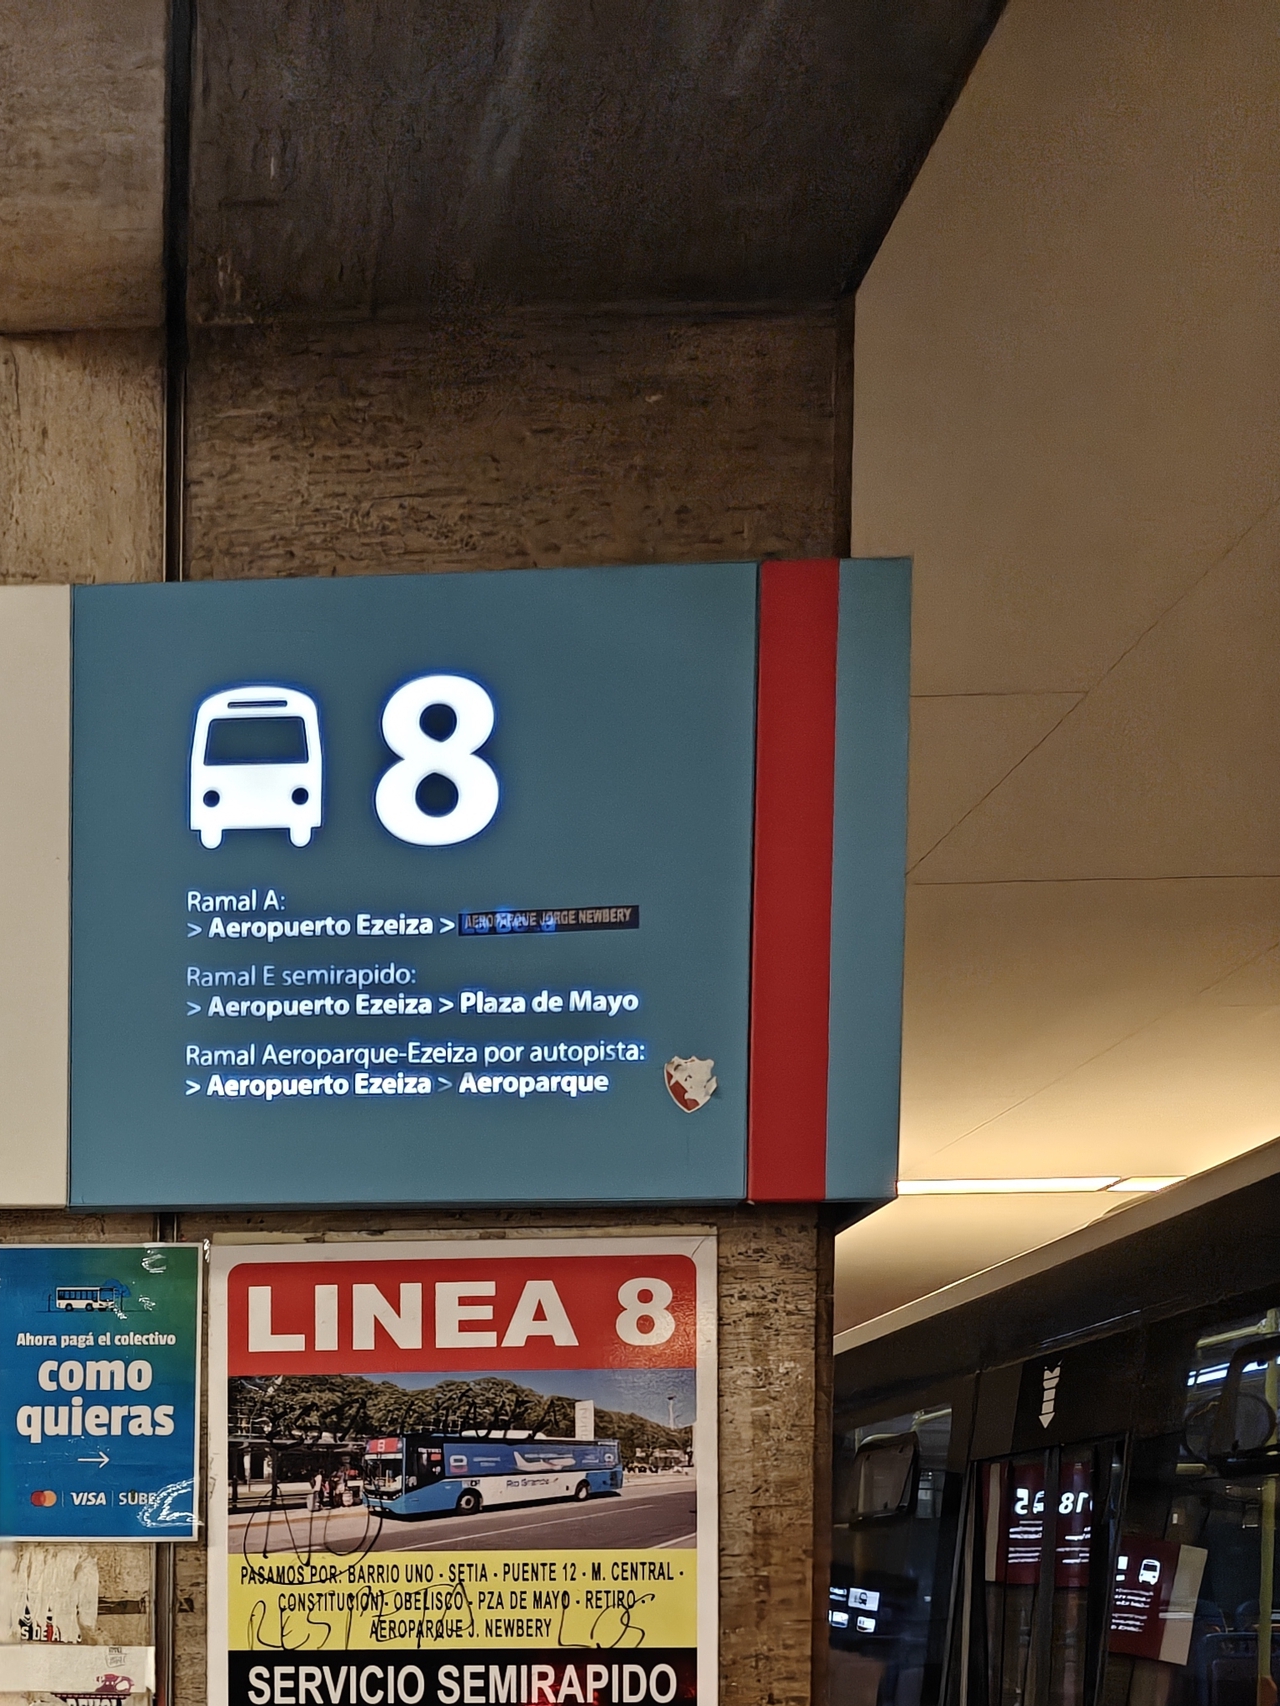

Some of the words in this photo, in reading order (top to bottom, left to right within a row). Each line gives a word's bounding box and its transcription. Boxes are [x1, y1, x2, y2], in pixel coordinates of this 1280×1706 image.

[376, 674, 499, 846] 8
[187, 889, 257, 912] Ramal
[263, 889, 285, 910] A:
[208, 916, 351, 942] Aeropuerto
[357, 913, 433, 935] Ezeiza
[579, 907, 632, 924] NEWBERY
[187, 965, 256, 987] Ramal
[263, 965, 275, 986] E
[282, 962, 416, 990] semirapido:
[208, 996, 350, 1021] Aeropuerto
[356, 993, 432, 1015] Ezeiza
[460, 991, 526, 1013] Plaza
[531, 990, 563, 1012] de
[569, 990, 639, 1016] Mayo
[186, 1043, 255, 1066] Ramal
[262, 1042, 477, 1069] Aeroparque-Ezeiza
[484, 1046, 525, 1067] por
[530, 1040, 645, 1066] autopista:
[206, 1074, 349, 1100] Aeropuerto
[355, 1072, 432, 1094] Ezeiza
[459, 1072, 609, 1098] Aeroparque
[248, 1280, 579, 1353] LINEA
[615, 1277, 683, 1350] 8
[16, 1332, 57, 1346] Ahora
[61, 1332, 94, 1348] pagá
[98, 1332, 111, 1346] el
[114, 1331, 176, 1346] colectivo
[38, 1360, 152, 1391] como
[16, 1396, 174, 1444] quieras
[71, 1492, 107, 1506] VISA
[346, 1564, 400, 1583] BARRIO
[405, 1563, 434, 1583] UNO
[448, 1563, 488, 1583] SETIA
[503, 1562, 557, 1582] PUENTE
[562, 1562, 577, 1581] 12
[591, 1562, 606, 1581] M.
[611, 1561, 674, 1581] CENTRAL
[478, 1591, 505, 1610] PZA
[510, 1590, 527, 1610] DE
[533, 1590, 570, 1610] MAYO
[585, 1589, 637, 1610] RETIRO
[467, 1618, 479, 1638] J.
[485, 1618, 552, 1638] NEWBERY
[248, 1665, 425, 1705] SERVICIO
[437, 1663, 677, 1706] SEMIRAPIDO
